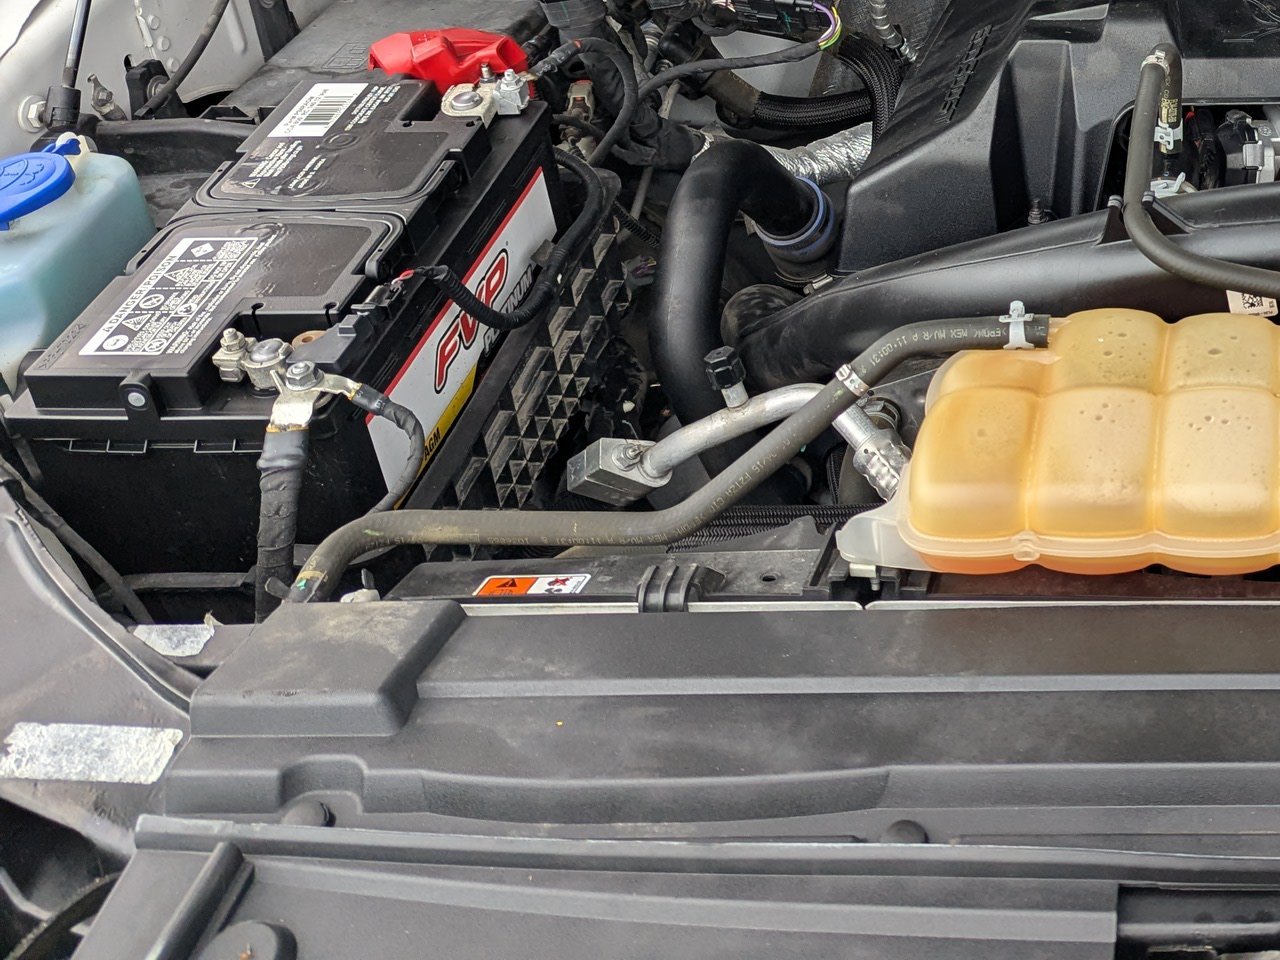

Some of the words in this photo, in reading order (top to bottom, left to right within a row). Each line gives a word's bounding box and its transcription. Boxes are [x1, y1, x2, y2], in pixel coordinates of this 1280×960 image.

[434, 248, 508, 394] FVP
[950, 328, 967, 338] MEX
[423, 429, 441, 459] AGM
